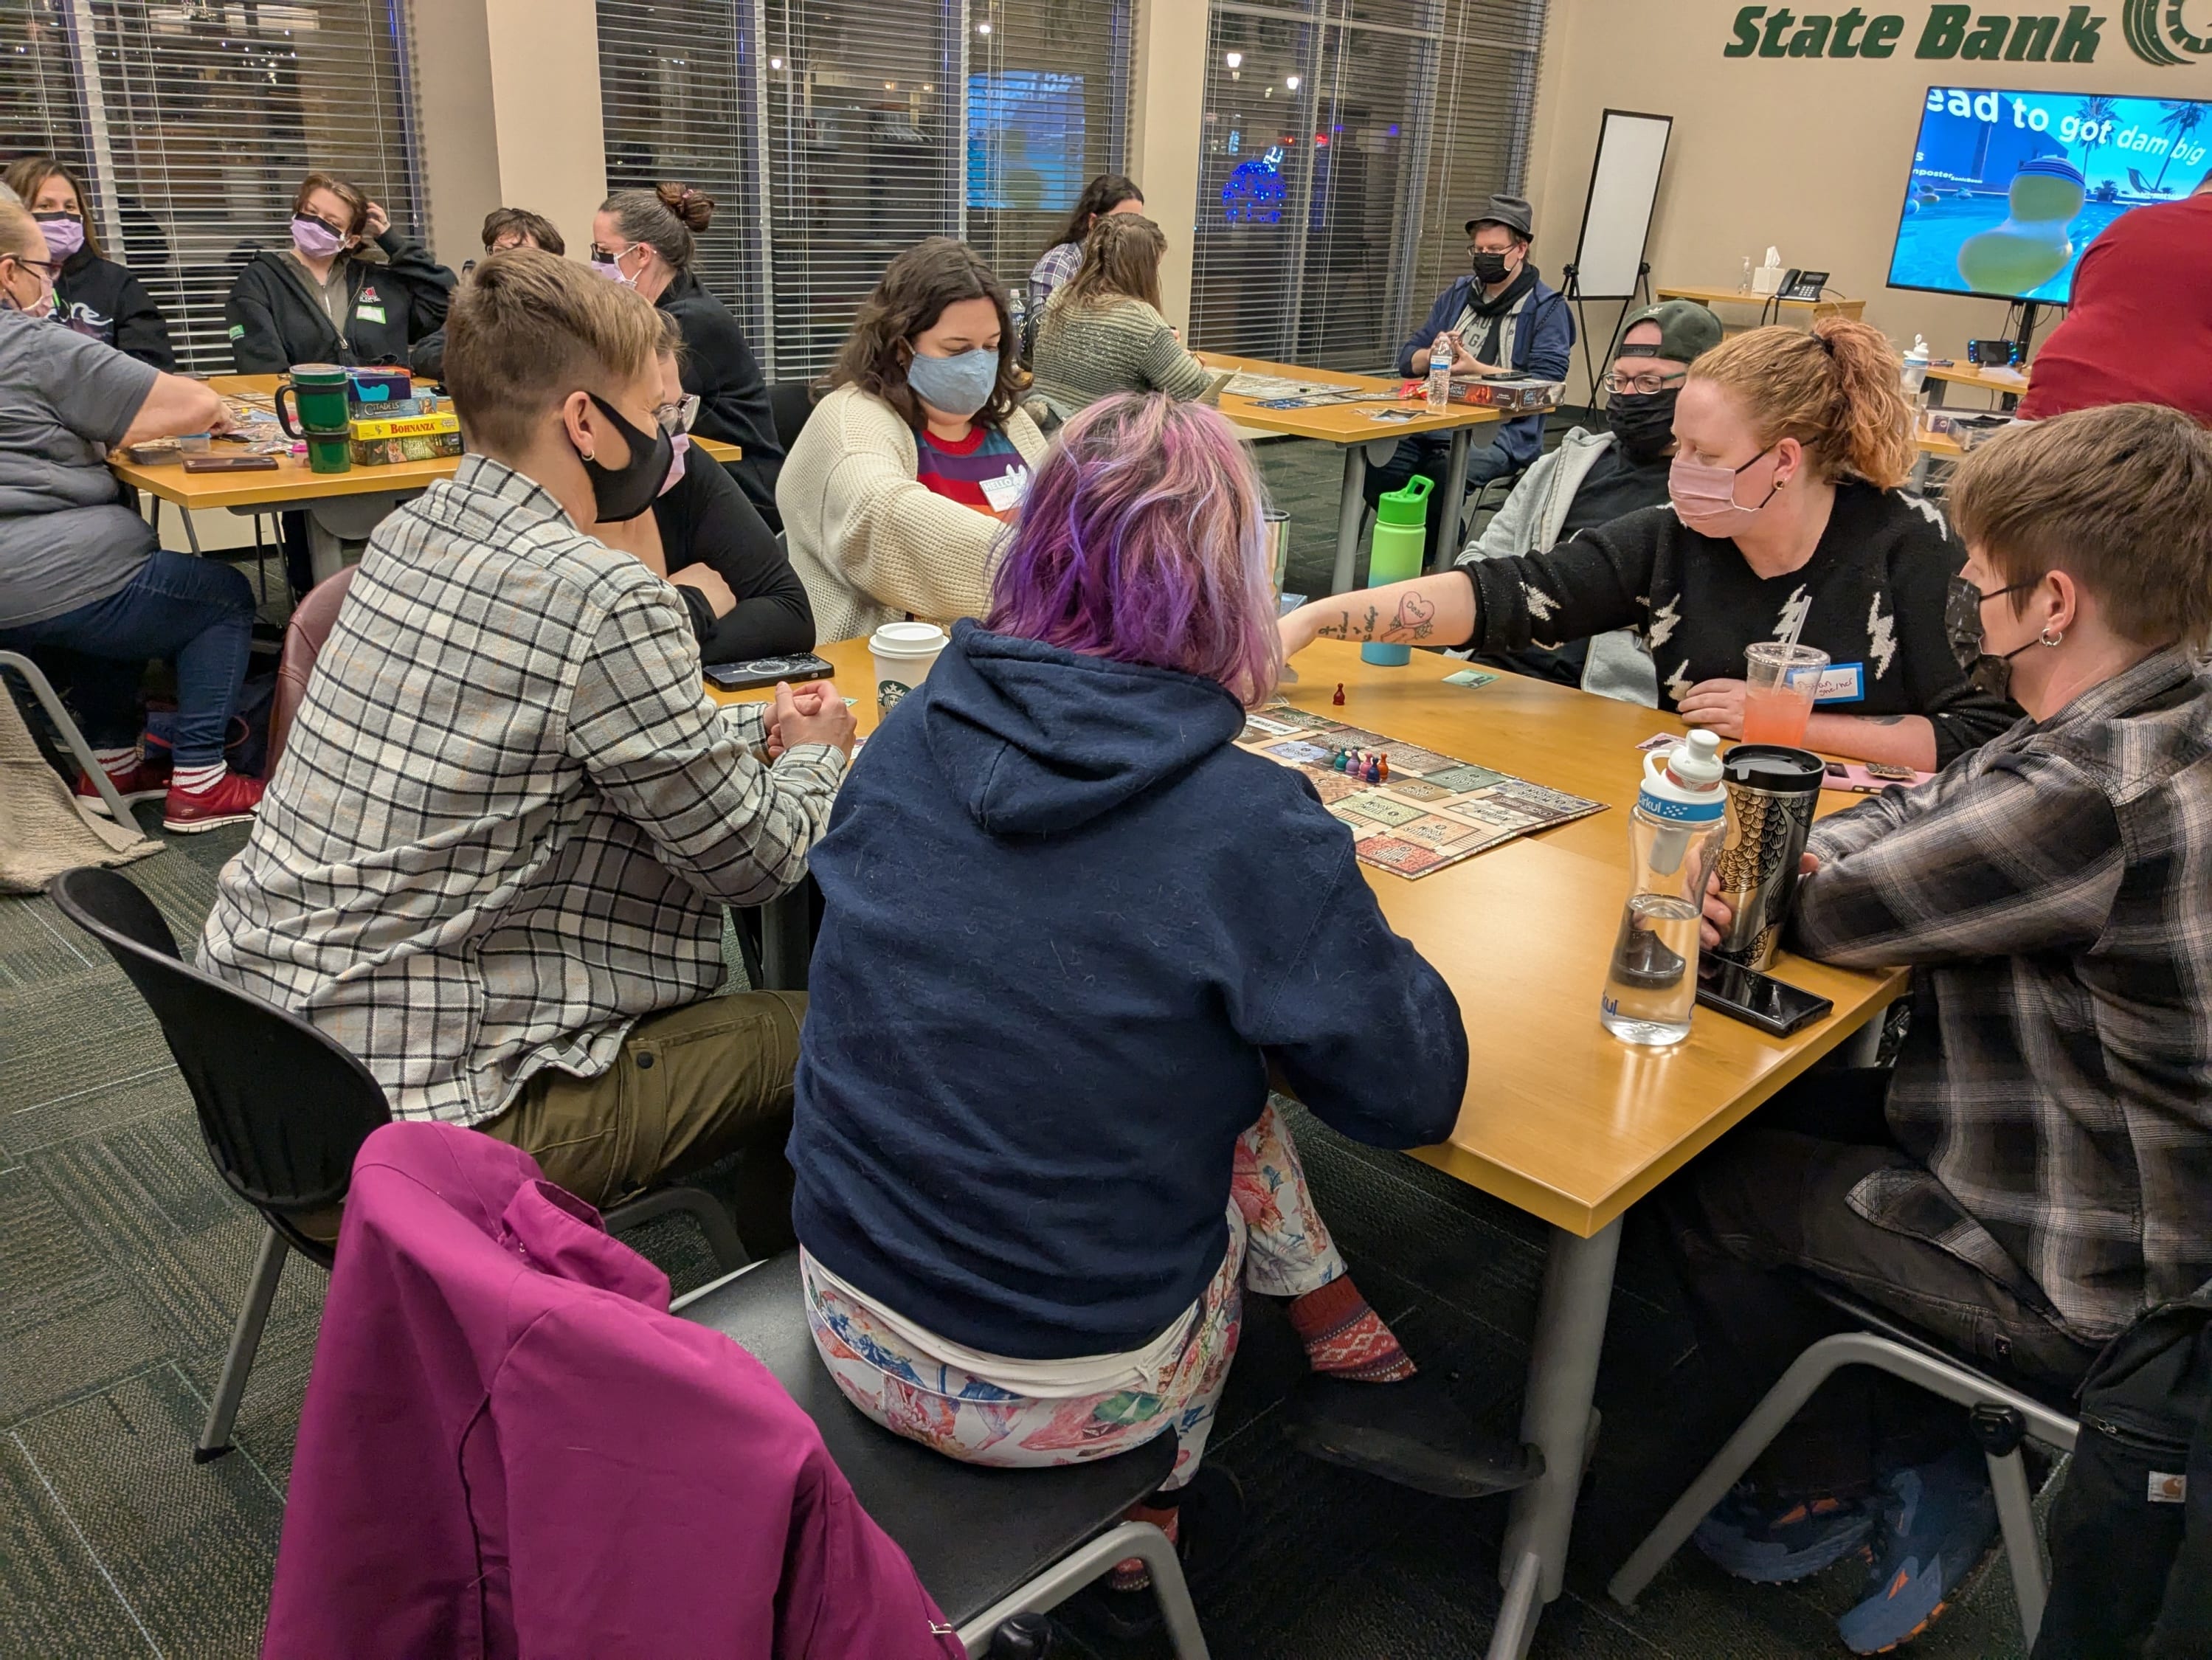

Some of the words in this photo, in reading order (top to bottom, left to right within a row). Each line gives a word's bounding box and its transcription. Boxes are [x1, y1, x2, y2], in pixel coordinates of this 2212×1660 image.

[1724, 6, 1905, 58] State
[1915, 4, 2106, 63] Bank
[2013, 97, 2049, 131] to
[2059, 116, 2112, 144] got
[2117, 125, 2169, 155] dam
[2170, 136, 2206, 165] big
[364, 401, 400, 416] CITADELS
[390, 422, 435, 435] BOHNANZA
[983, 479, 1012, 491] HELLO
[1406, 600, 1425, 619] Dead
